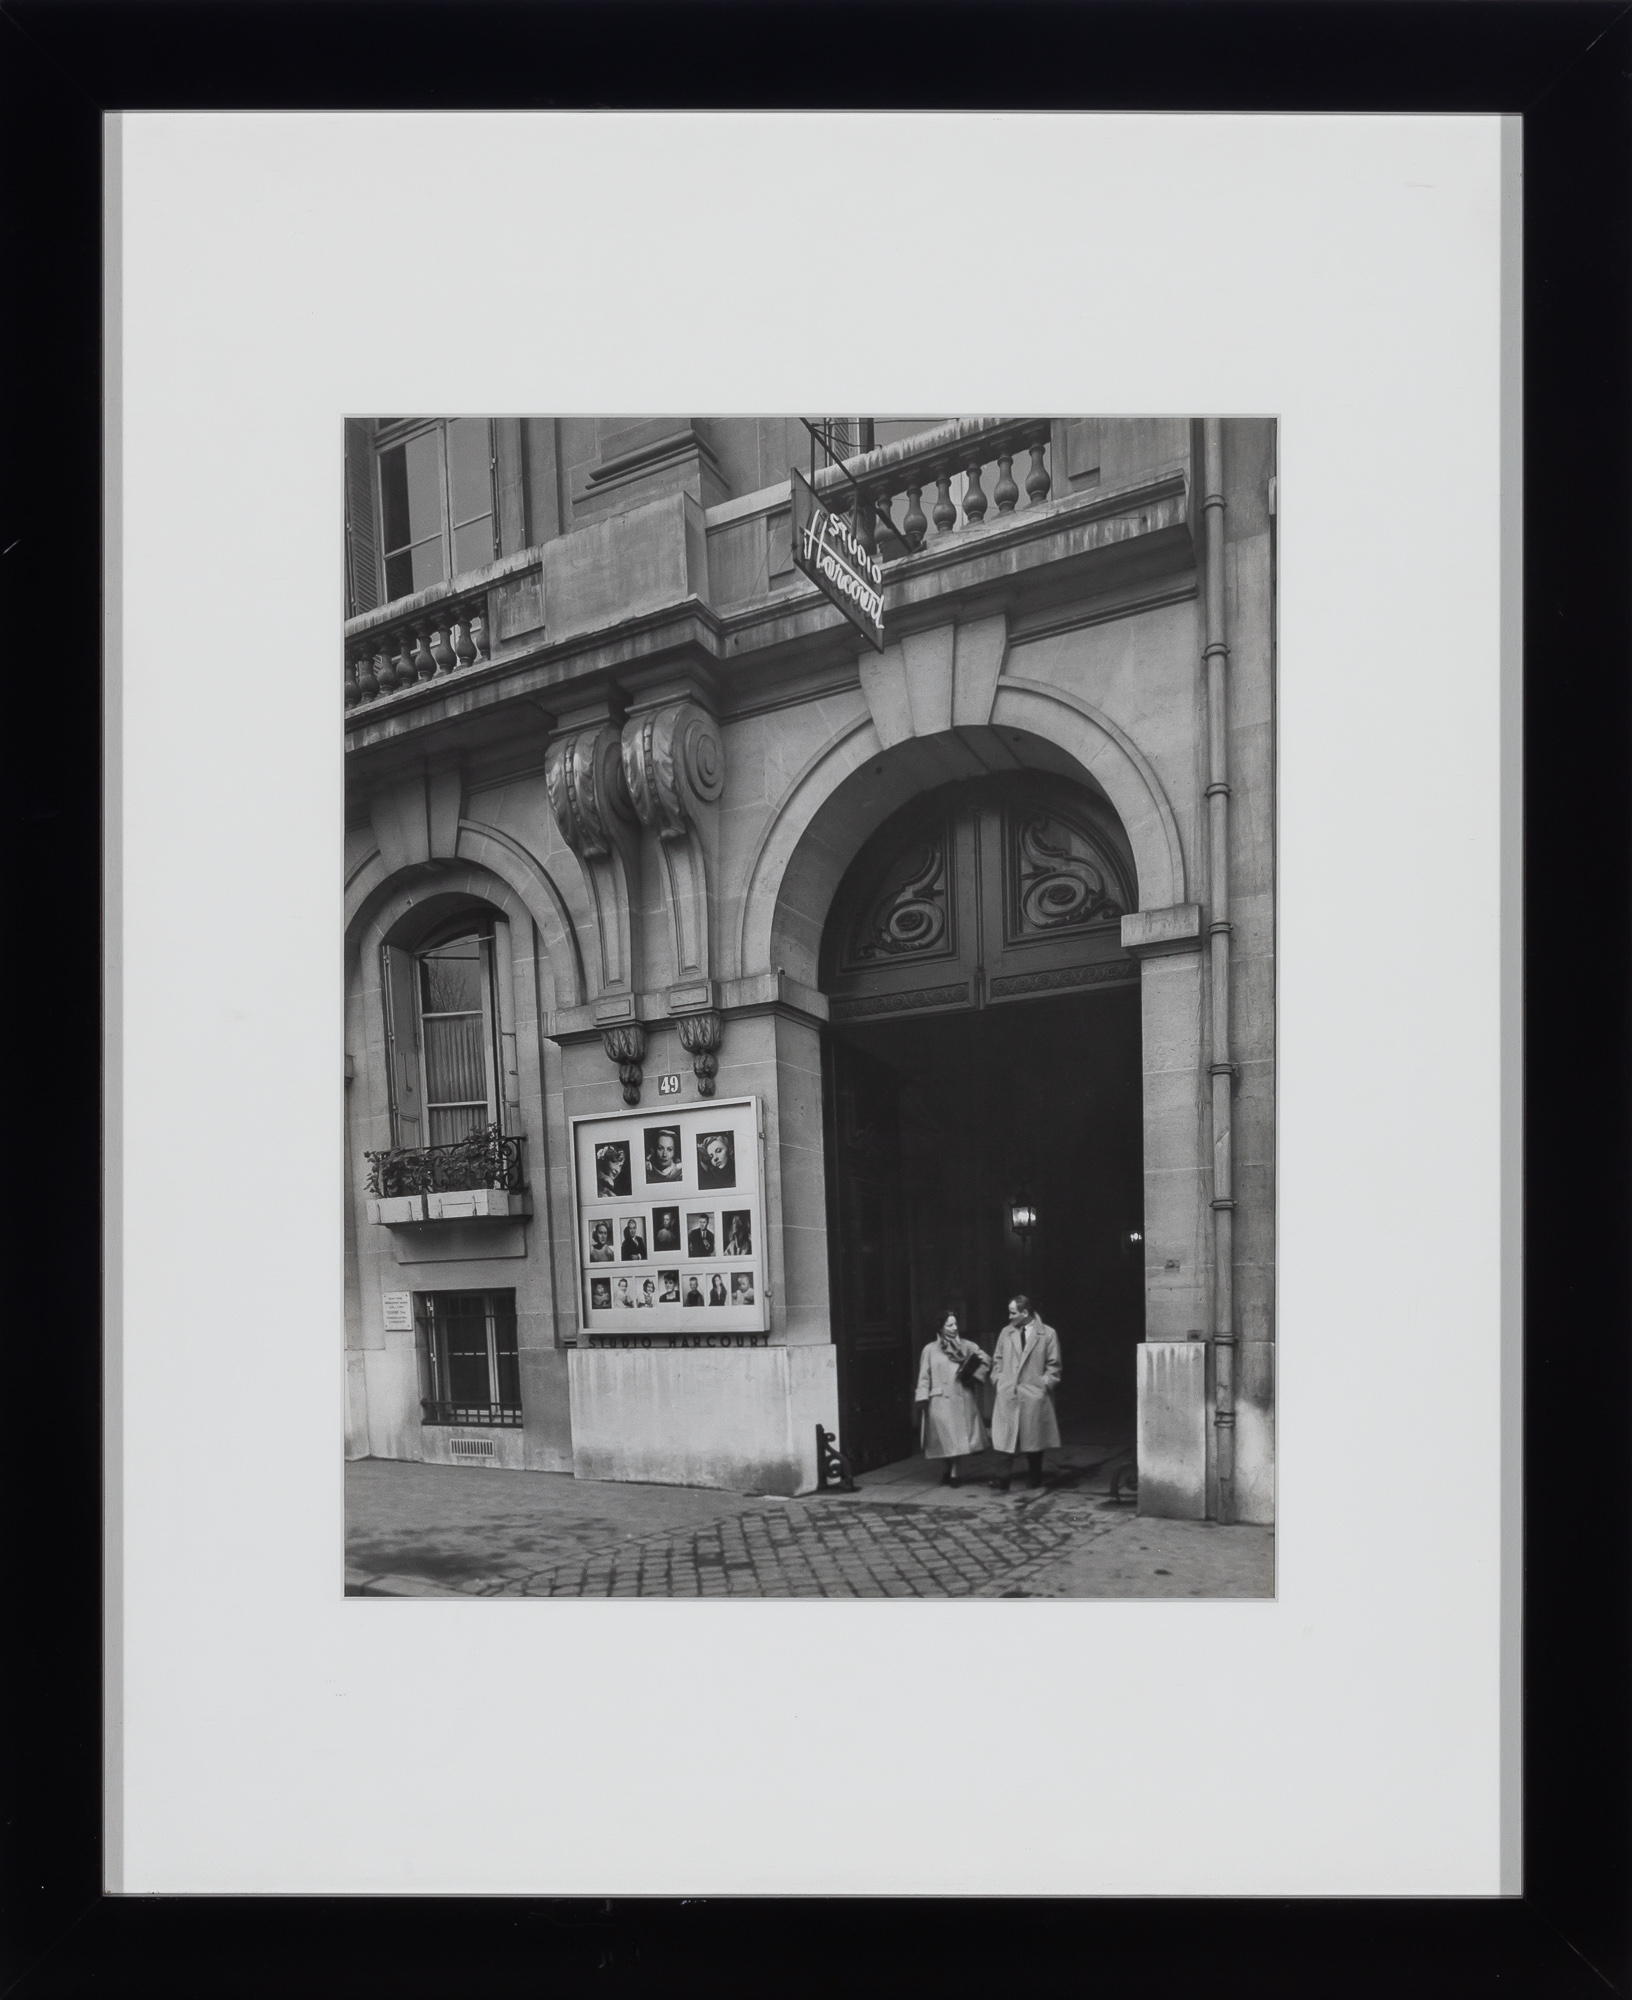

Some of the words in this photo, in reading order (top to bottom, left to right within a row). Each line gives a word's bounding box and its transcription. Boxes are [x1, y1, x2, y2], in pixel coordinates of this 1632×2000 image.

[804, 509, 885, 629] Harcourt
[828, 513, 882, 584] STUDIO
[660, 1075, 679, 1094] 49
[588, 1335, 652, 1349] STUDIO
[668, 1334, 770, 1348] HARCOURT
